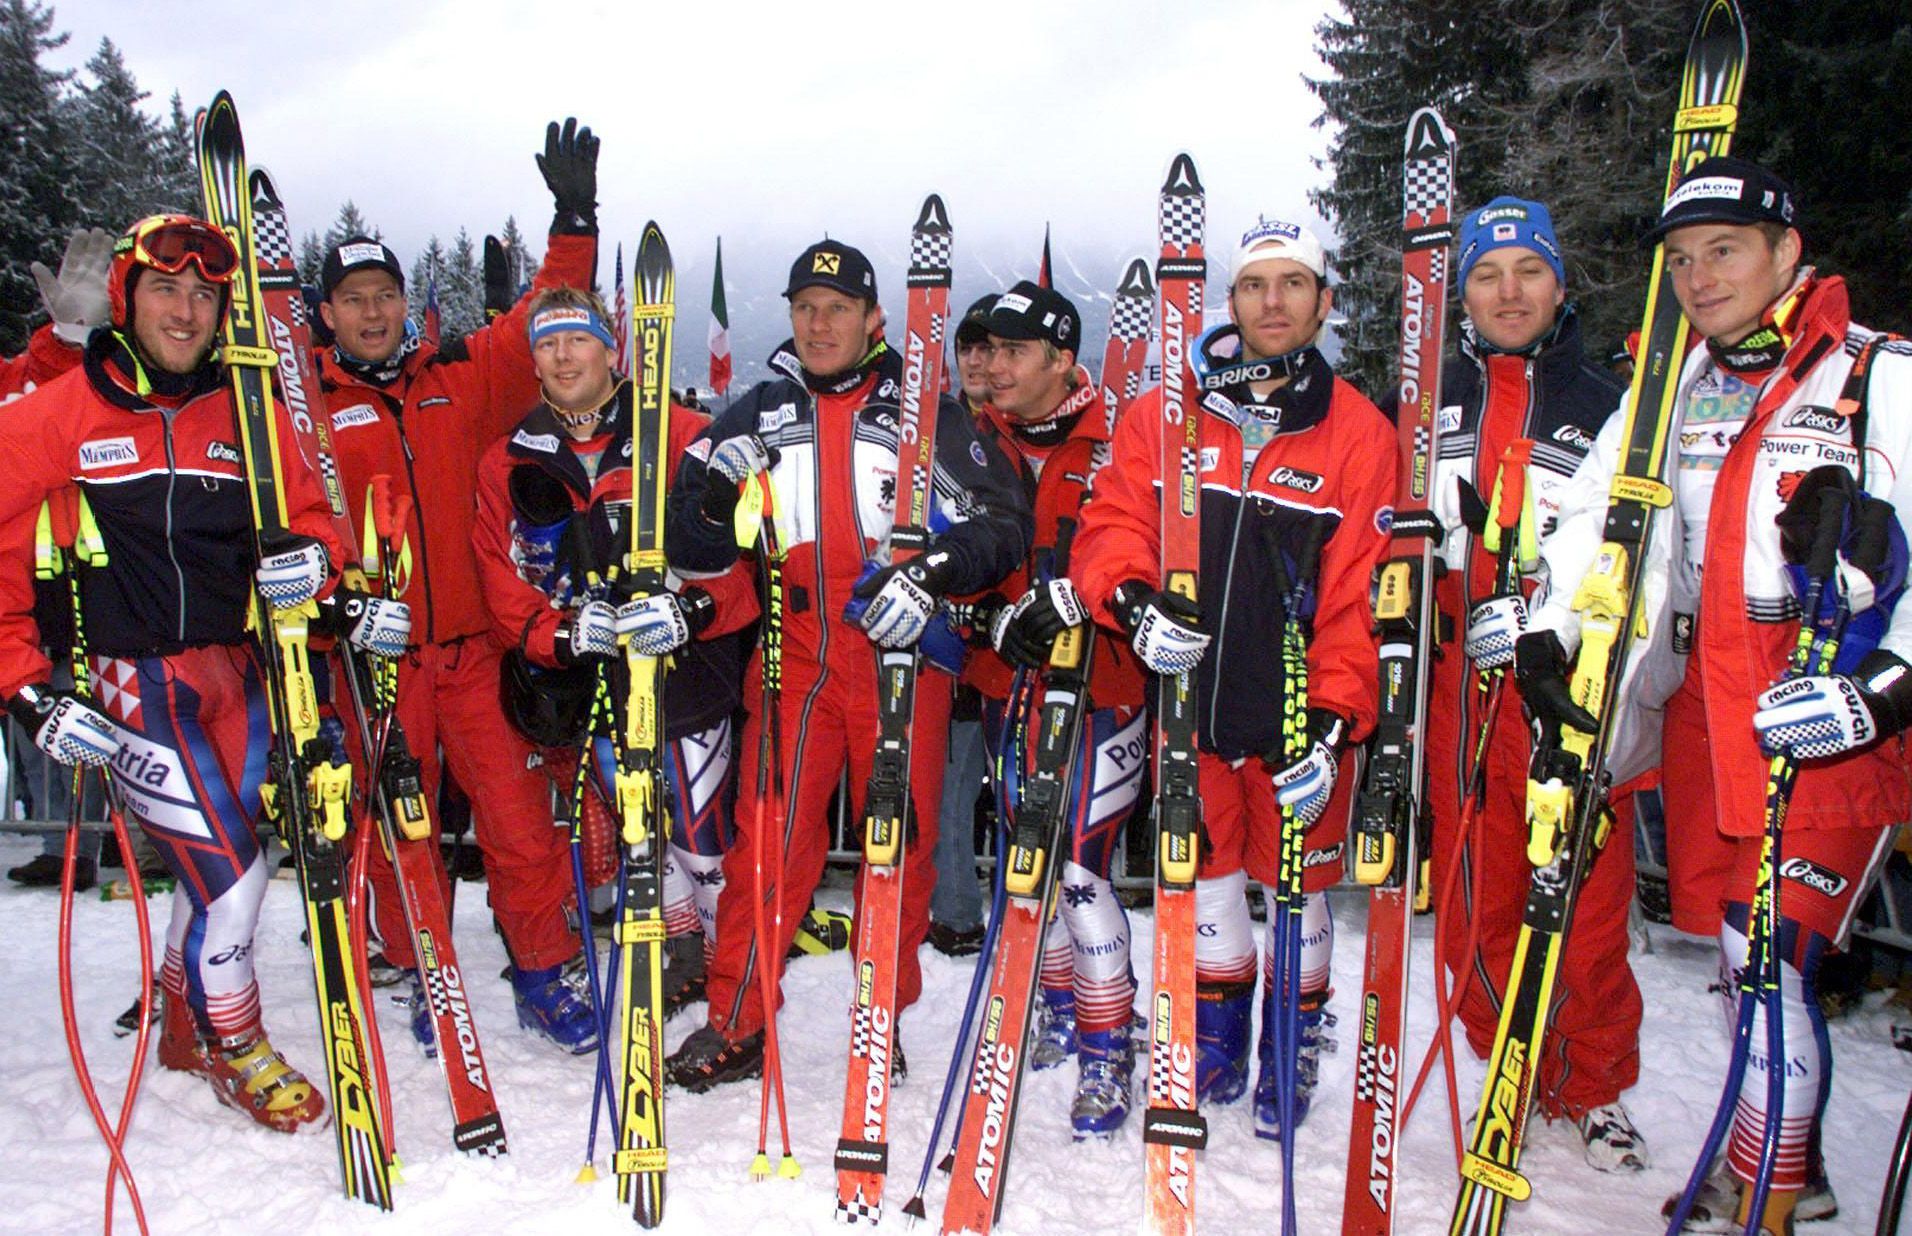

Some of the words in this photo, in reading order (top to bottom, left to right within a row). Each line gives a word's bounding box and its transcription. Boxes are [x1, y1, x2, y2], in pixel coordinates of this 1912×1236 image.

[1401, 274, 1425, 404] ATOMIC
[271, 315, 313, 434] ATOMIC
[643, 328, 659, 410] HEAD
[1165, 300, 1185, 426] ATOMIC
[1205, 363, 1271, 389] BRIKO
[901, 330, 925, 446] ATOMIC
[1046, 386, 1096, 421] RIKO
[1790, 407, 1839, 432] asics
[80, 444, 136, 466] MEMPHIS
[1760, 439, 1810, 455] Power
[1618, 479, 1659, 492] HEAD
[271, 552, 306, 567] racing
[620, 600, 650, 615] racing
[664, 595, 688, 643] reusch
[893, 577, 933, 617] reusch
[1054, 581, 1077, 621] reusch
[360, 599, 382, 647] reusch
[1138, 612, 1157, 656] eusch
[1768, 679, 1815, 704] racing
[1833, 673, 1870, 741] reusch
[43, 699, 74, 753] reusch
[118, 742, 171, 787] tria
[1284, 760, 1316, 783] racing
[1785, 859, 1837, 894] asics
[442, 965, 487, 1093] ATOMIC
[1365, 998, 1378, 1043] DH/SG
[331, 1001, 371, 1133] CYBER
[629, 1006, 651, 1138] CYBER
[864, 1006, 889, 1143] ATOMIC
[974, 1043, 1014, 1199] ATOMIC
[1150, 1122, 1203, 1136] ATOMIC
[1369, 1044, 1396, 1213] ATOMIC
[837, 1150, 882, 1162] ATOMIC
[1474, 1160, 1517, 1181] HEAD
